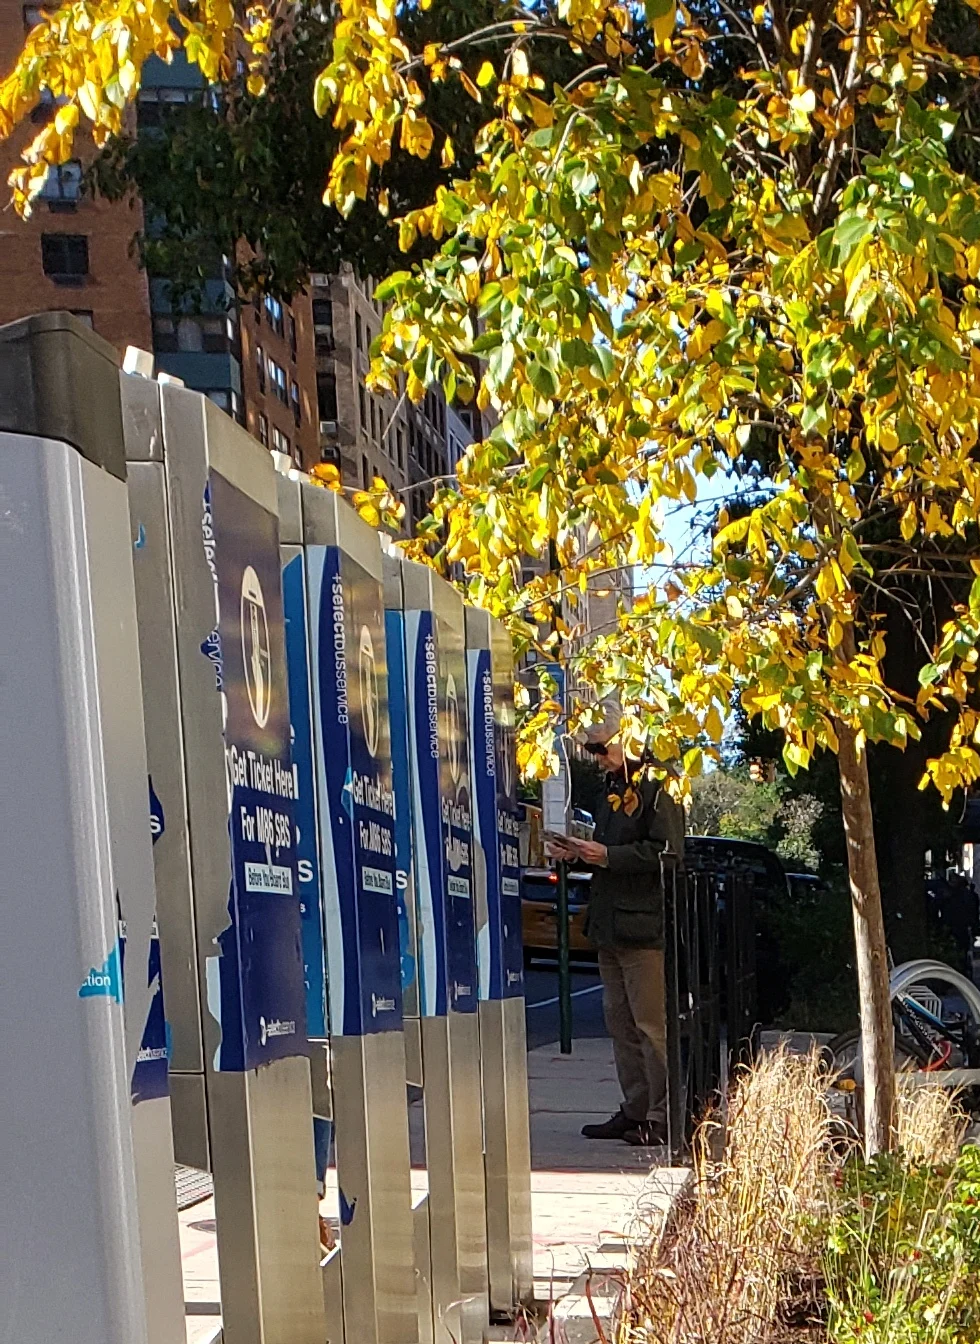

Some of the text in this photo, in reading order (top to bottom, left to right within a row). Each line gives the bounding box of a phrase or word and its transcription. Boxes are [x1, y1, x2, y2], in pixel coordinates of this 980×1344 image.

[231, 744, 248, 788] Get
[247, 751, 275, 795] Ticket
[274, 759, 293, 800] Here
[240, 805, 291, 848] For M86 SBS
